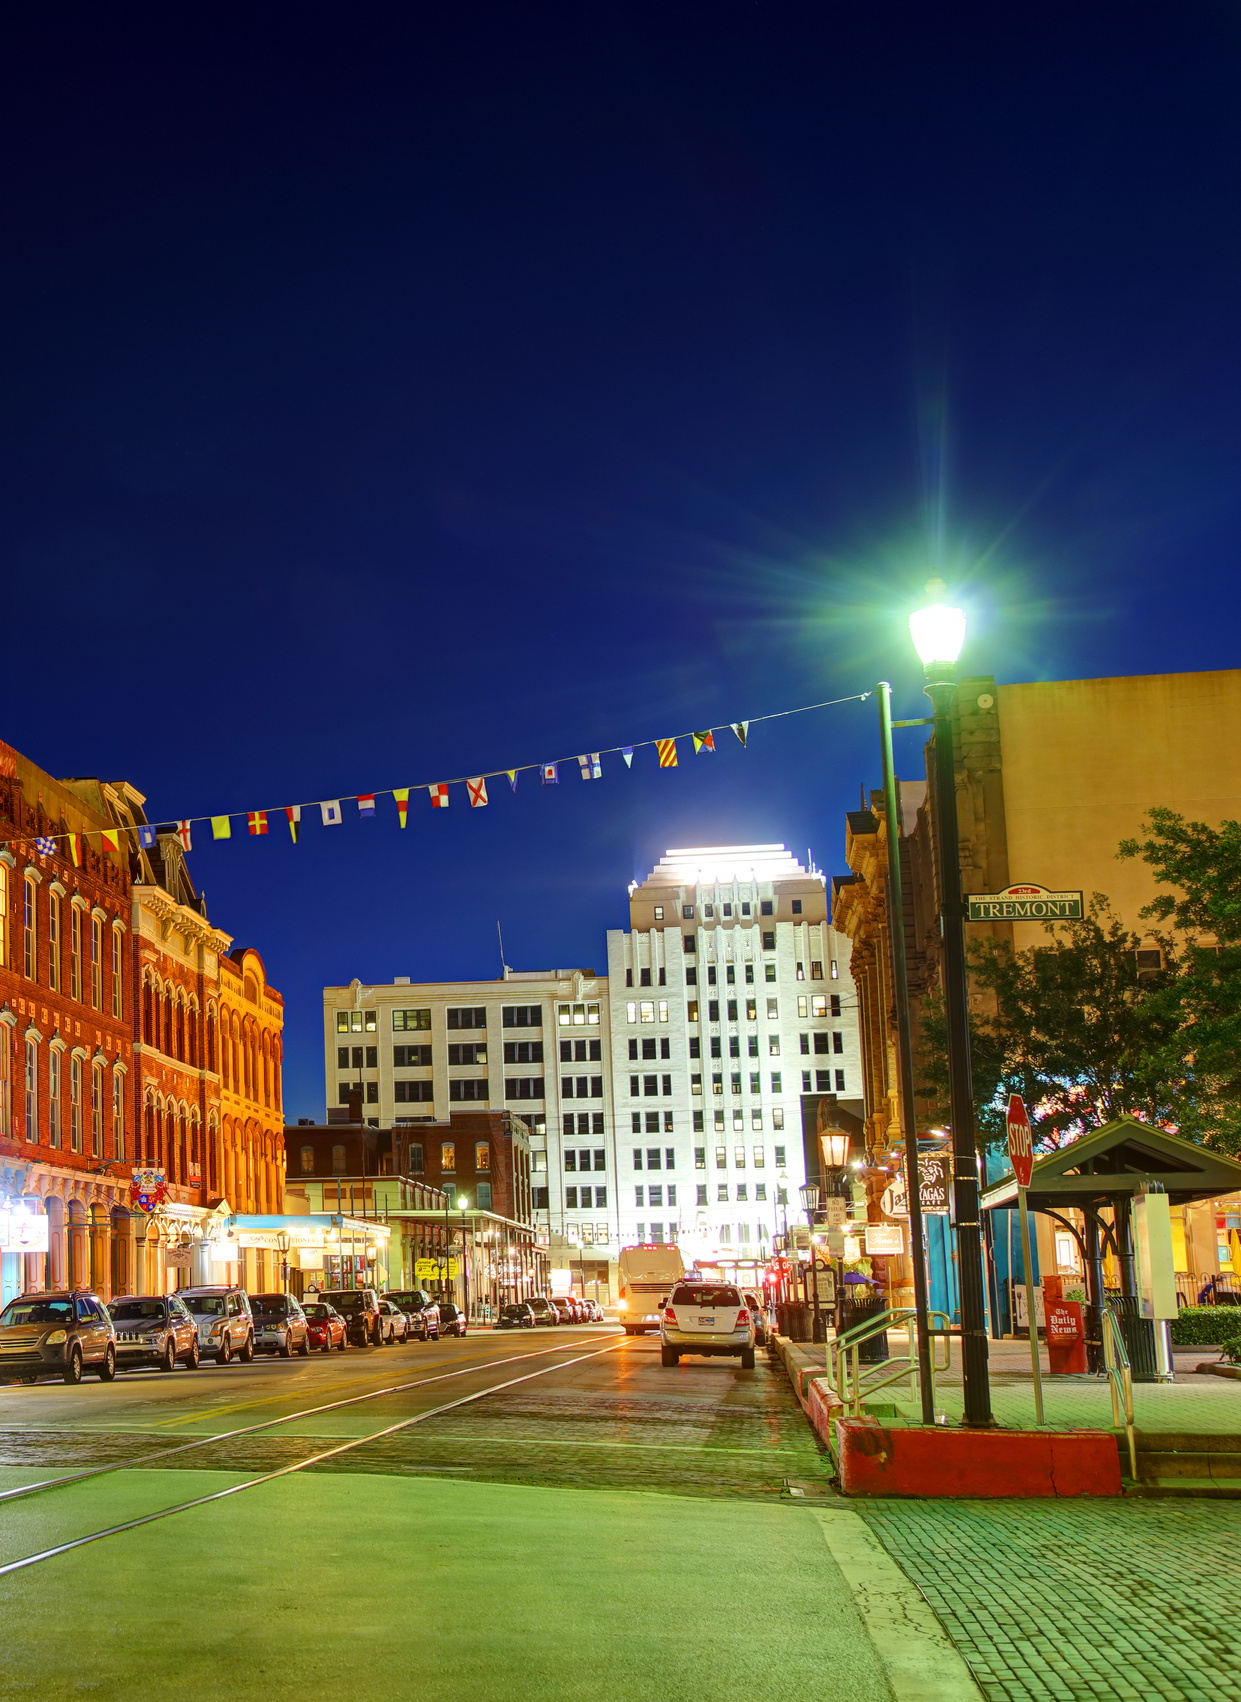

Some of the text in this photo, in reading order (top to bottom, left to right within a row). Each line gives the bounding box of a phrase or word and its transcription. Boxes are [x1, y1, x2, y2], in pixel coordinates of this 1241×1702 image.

[975, 902, 1074, 917] TREMONT
[1009, 1122, 1030, 1158] STOP
[869, 1233, 899, 1244] Tina's
[1050, 1315, 1076, 1326] Daily
